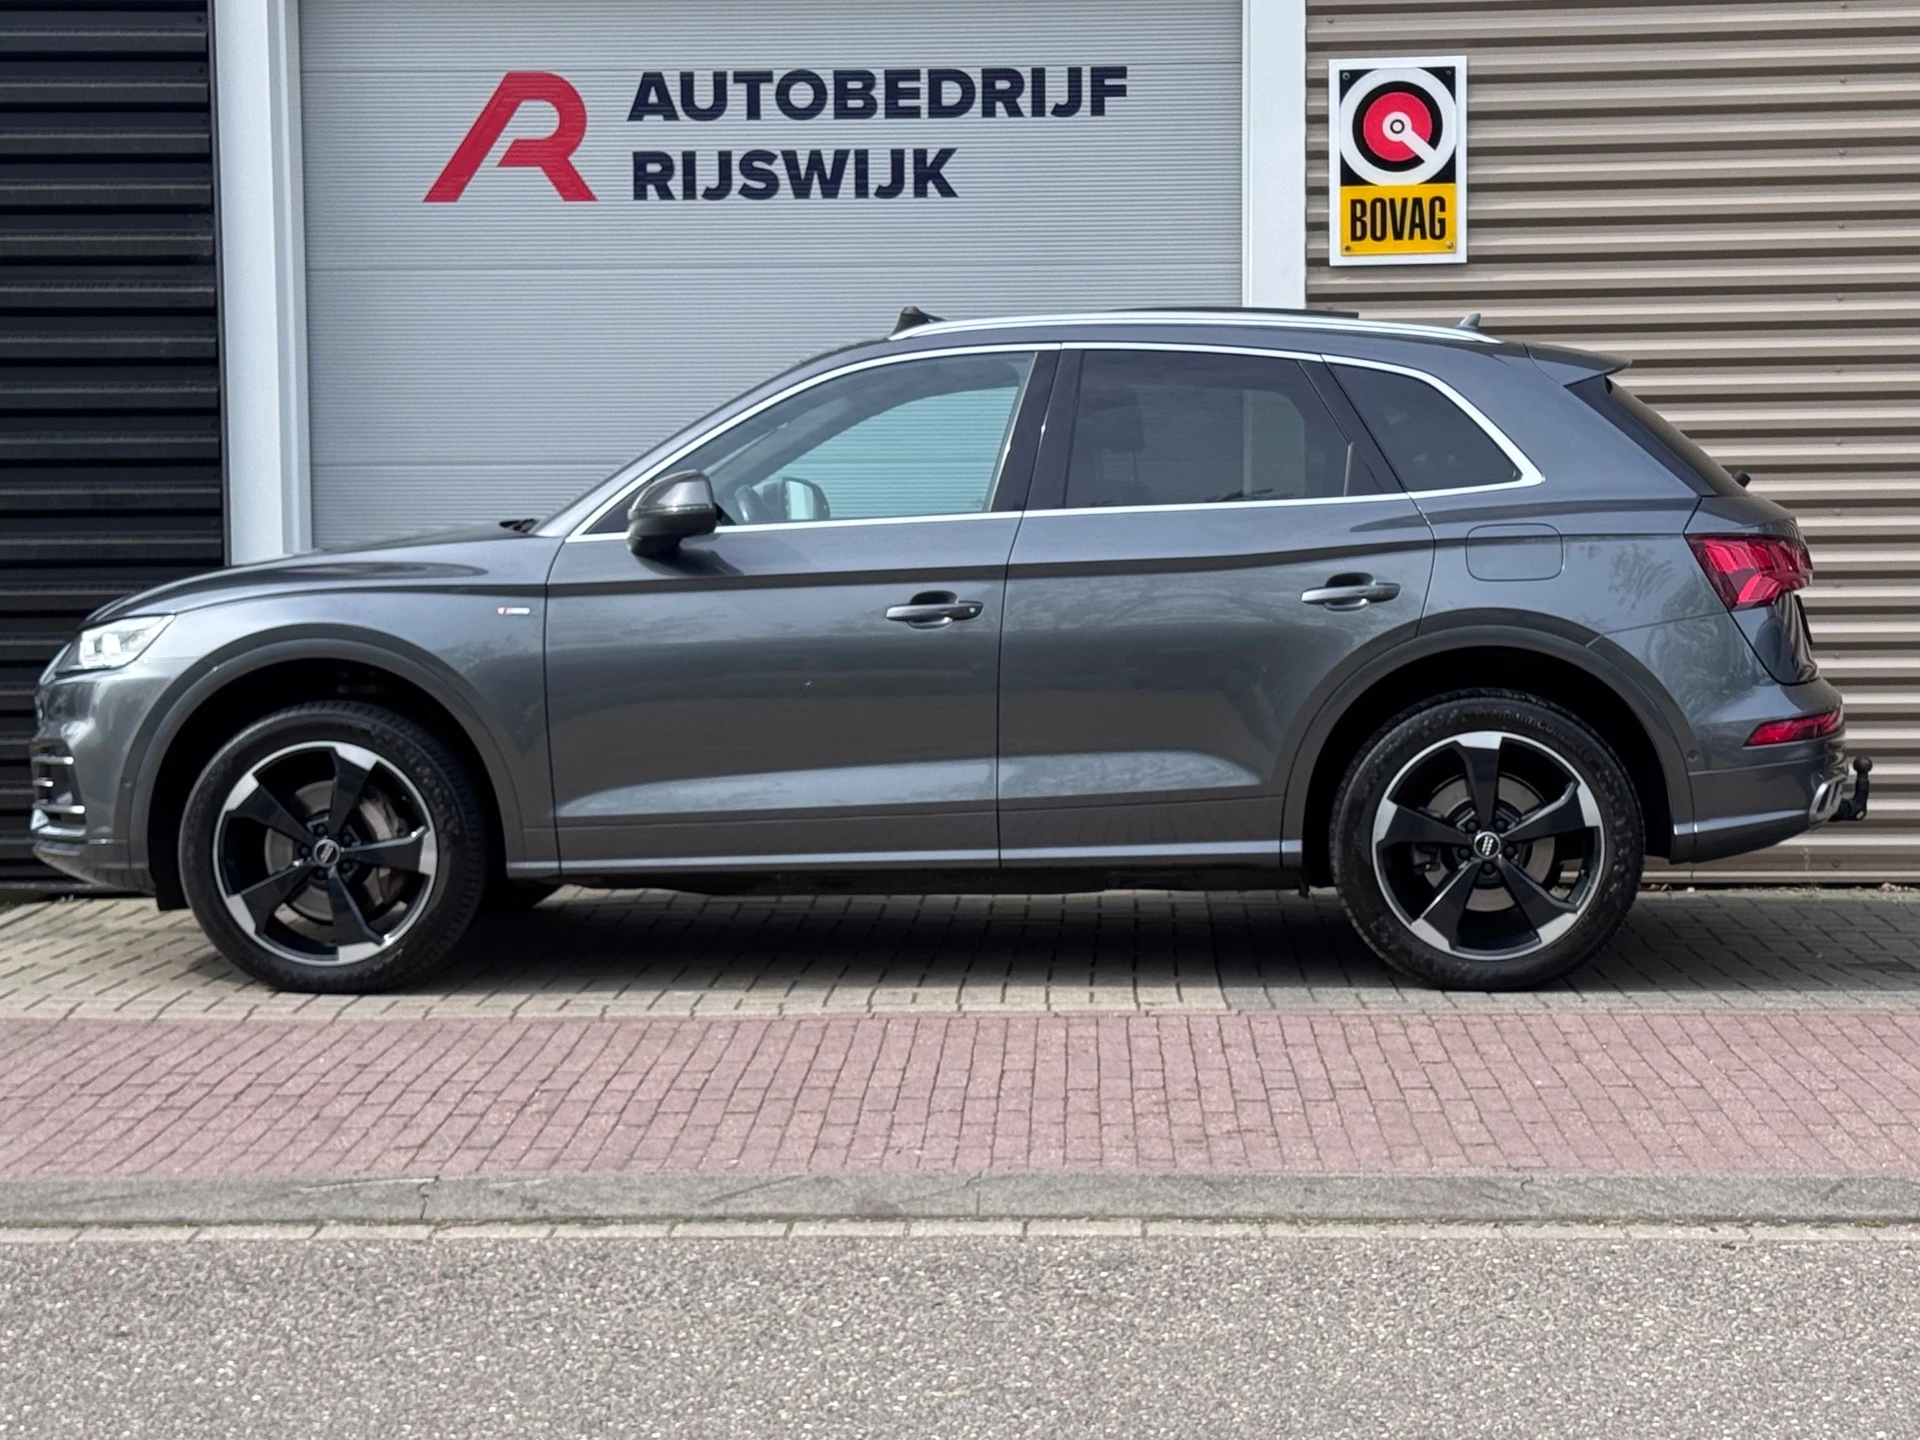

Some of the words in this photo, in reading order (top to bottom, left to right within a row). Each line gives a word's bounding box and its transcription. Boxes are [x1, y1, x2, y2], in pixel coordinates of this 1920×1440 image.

[628, 66, 1127, 121] AUTOBEDRIJF
[633, 148, 957, 200] RIJSWIJK
[1351, 196, 1446, 241] BOVAG
